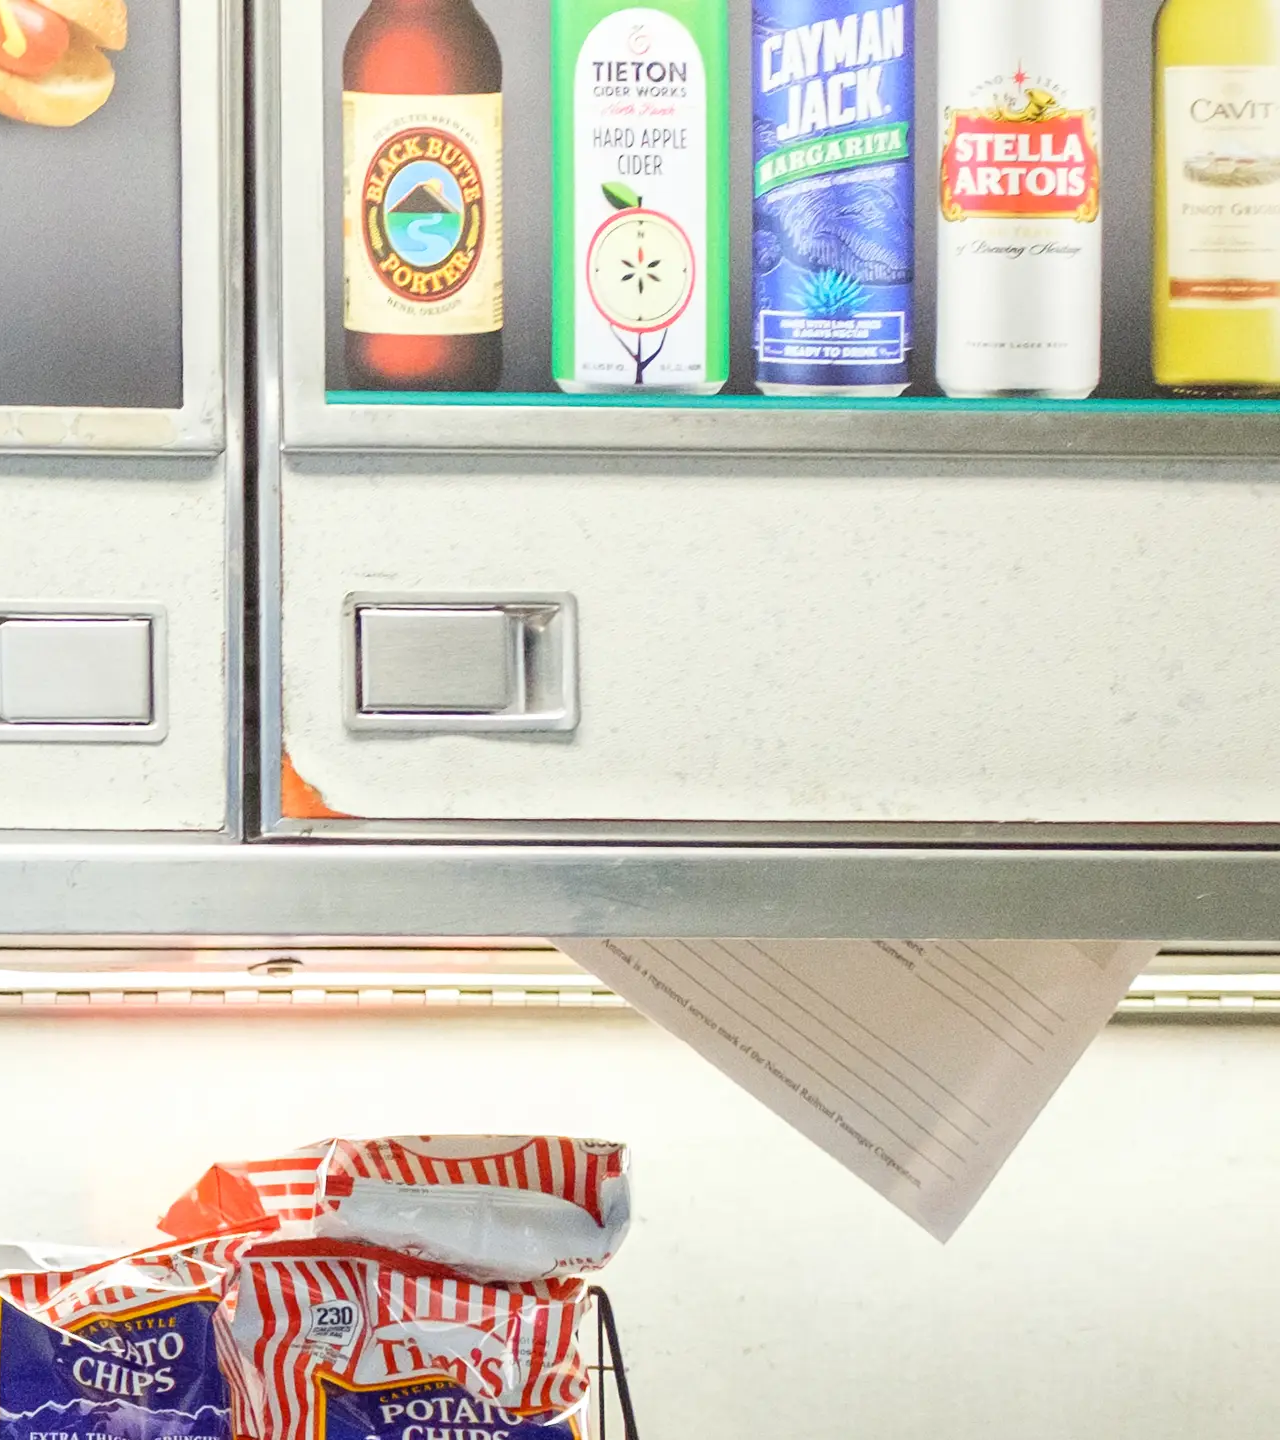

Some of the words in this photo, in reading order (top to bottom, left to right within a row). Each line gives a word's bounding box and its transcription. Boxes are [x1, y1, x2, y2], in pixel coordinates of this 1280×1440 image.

[761, 4, 904, 95] CAYMAN
[592, 61, 688, 84] TIETON
[592, 86, 630, 98] CIDER
[636, 86, 688, 98] WORKS
[592, 127, 634, 150] HARD
[641, 128, 688, 150] APPLE
[759, 128, 903, 181] MARGARITA
[955, 132, 1085, 163] STELLA
[366, 136, 423, 204] BLACK
[425, 136, 481, 203] BUTTE
[618, 154, 664, 176] CIDER
[954, 166, 1086, 197] ARTOIS
[379, 250, 471, 294] PORTER
[648, 973, 690, 1008] registered
[764, 1060, 802, 1092] National
[799, 1087, 836, 1119] Railroad
[835, 1114, 874, 1150] Passenger
[316, 1306, 353, 1326] 230
[72, 1356, 176, 1397] CHIPS
[376, 1338, 503, 1400] Tim's
